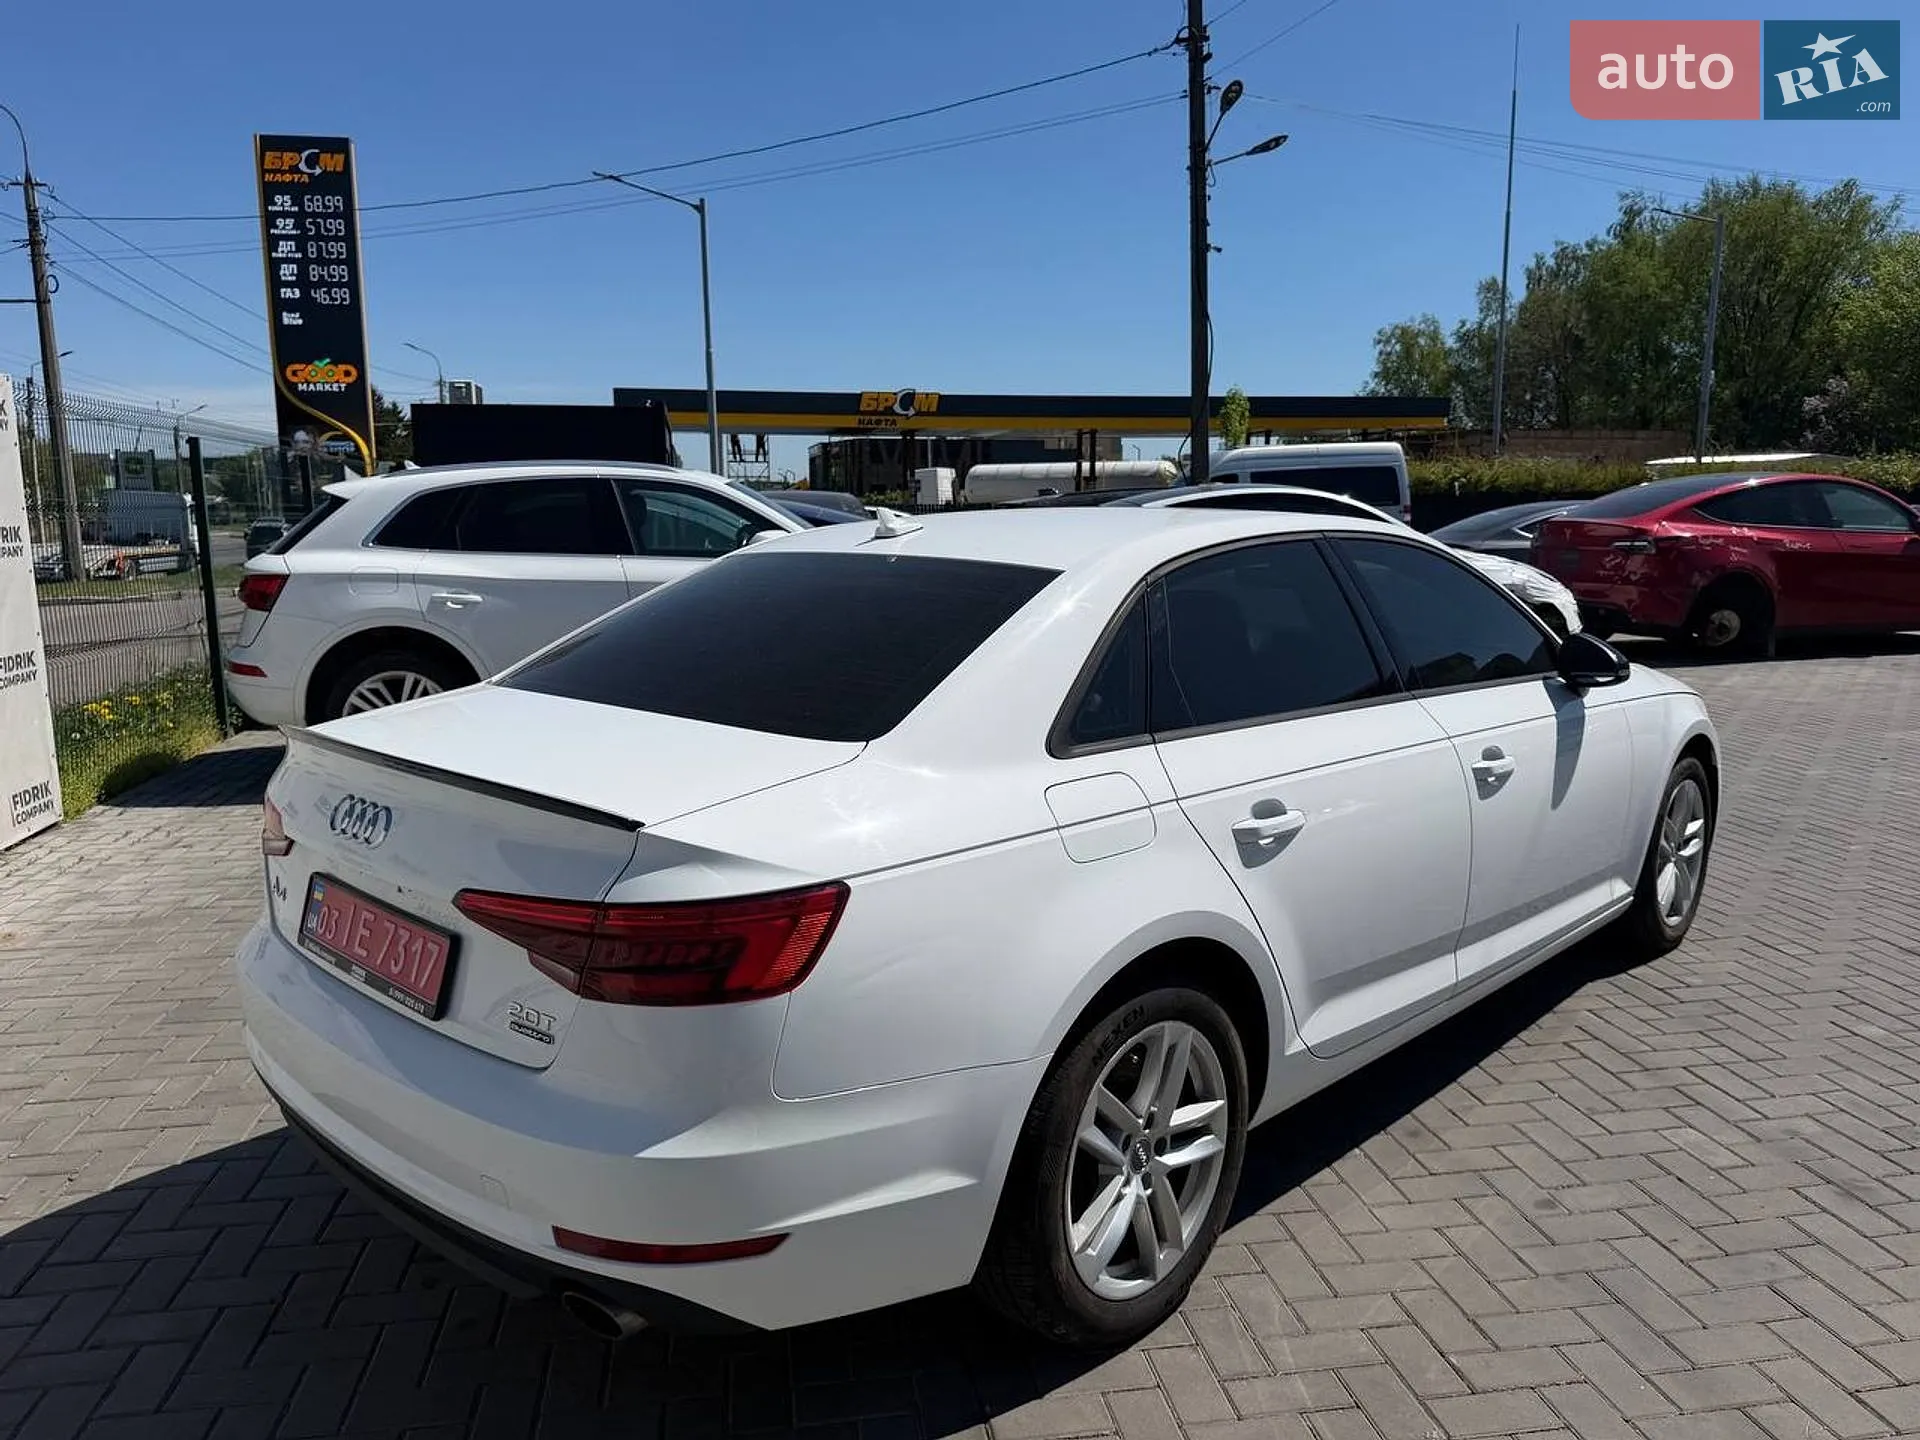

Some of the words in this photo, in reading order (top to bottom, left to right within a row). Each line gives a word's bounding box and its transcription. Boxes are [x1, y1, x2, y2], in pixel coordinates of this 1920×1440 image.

[264, 172, 310, 184] НАФТА
[274, 194, 292, 206] 95
[303, 194, 344, 213] 68.99
[275, 217, 295, 230] 95
[305, 218, 345, 237] 57.99
[277, 241, 296, 254] ДП
[307, 241, 348, 260] 87.99
[279, 263, 298, 277] ДП
[308, 264, 349, 283] 84.99
[280, 287, 301, 299] ГАЗ
[310, 287, 350, 305] 46.99
[285, 362, 359, 384] GOOD
[297, 383, 346, 392] MARKET
[0, 525, 22, 543] RIK
[12, 780, 52, 811] FIDRIK
[317, 905, 340, 940] 03
[376, 919, 441, 989] 7317
